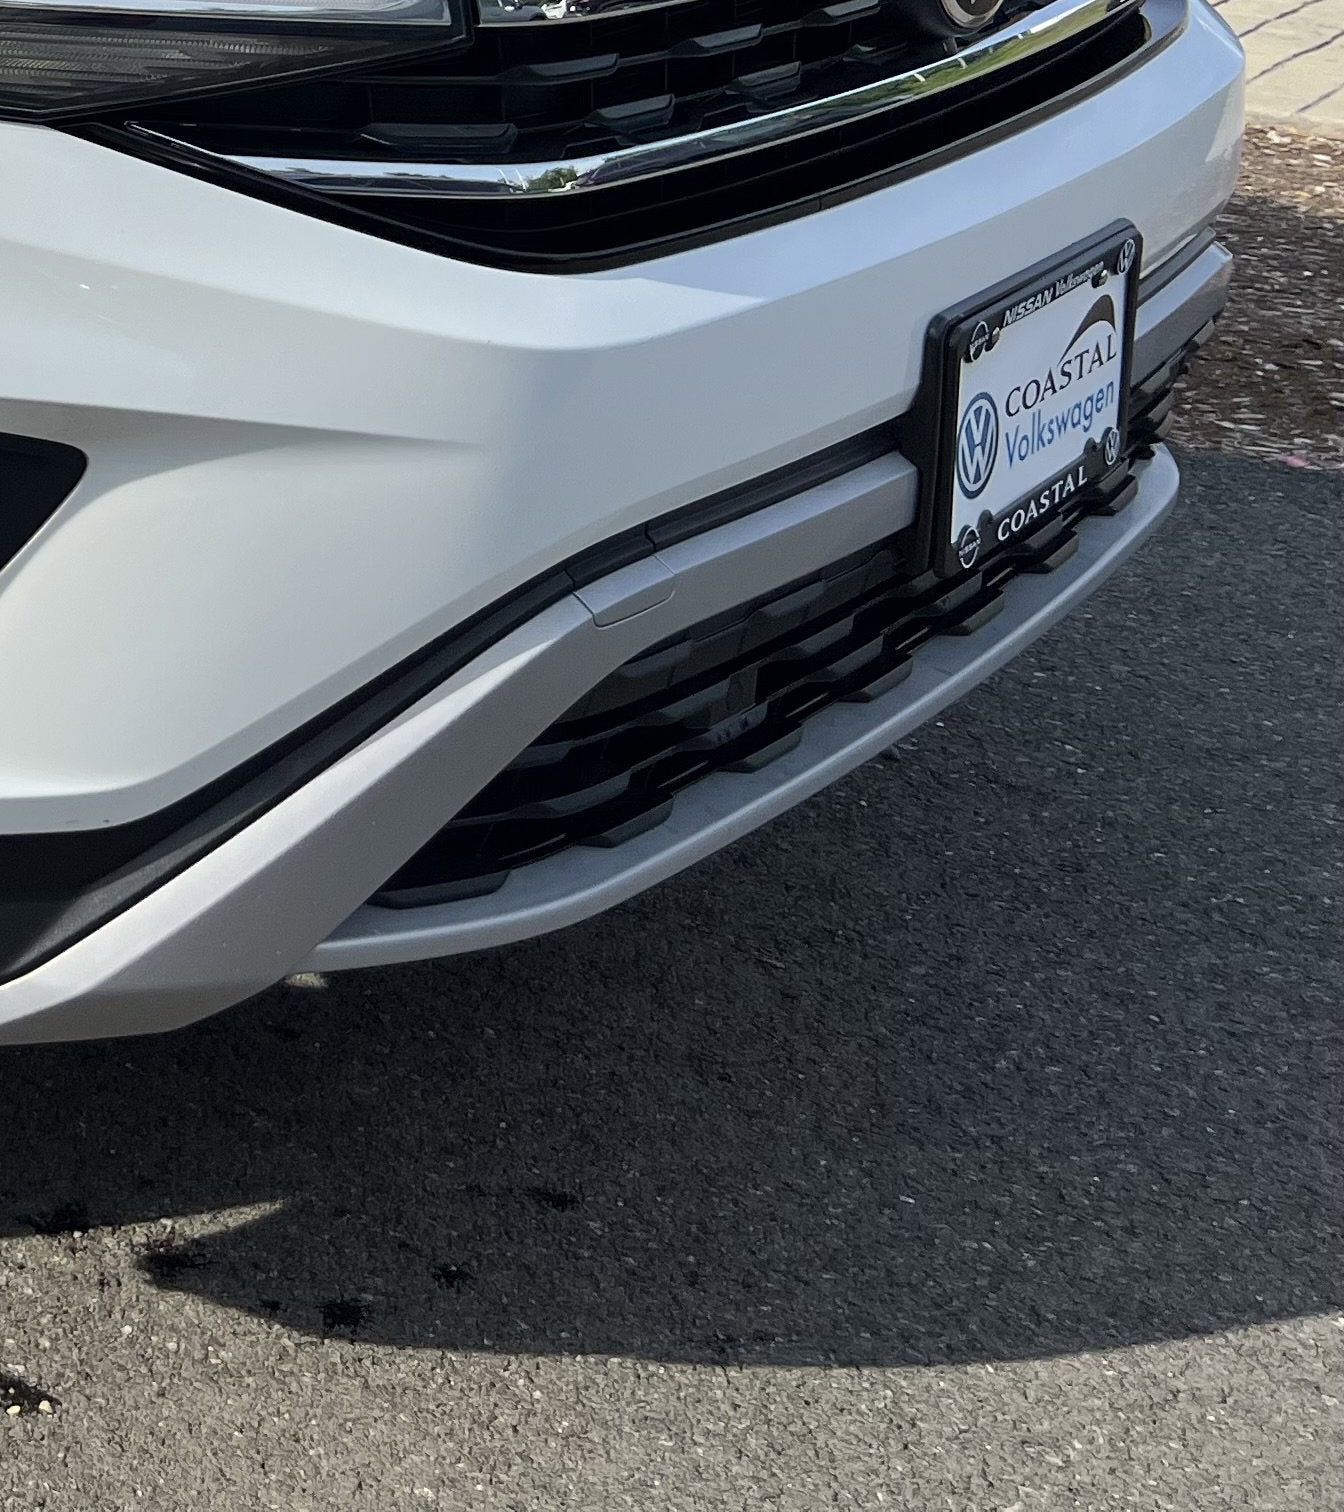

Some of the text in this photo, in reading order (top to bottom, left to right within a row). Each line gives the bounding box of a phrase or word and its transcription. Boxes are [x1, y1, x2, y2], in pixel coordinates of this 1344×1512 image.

[1003, 288, 1054, 327] NISSAN
[1005, 333, 1117, 418] COASTAL
[1005, 380, 1115, 468] Volkswagen
[997, 465, 1088, 541] COASTAL
